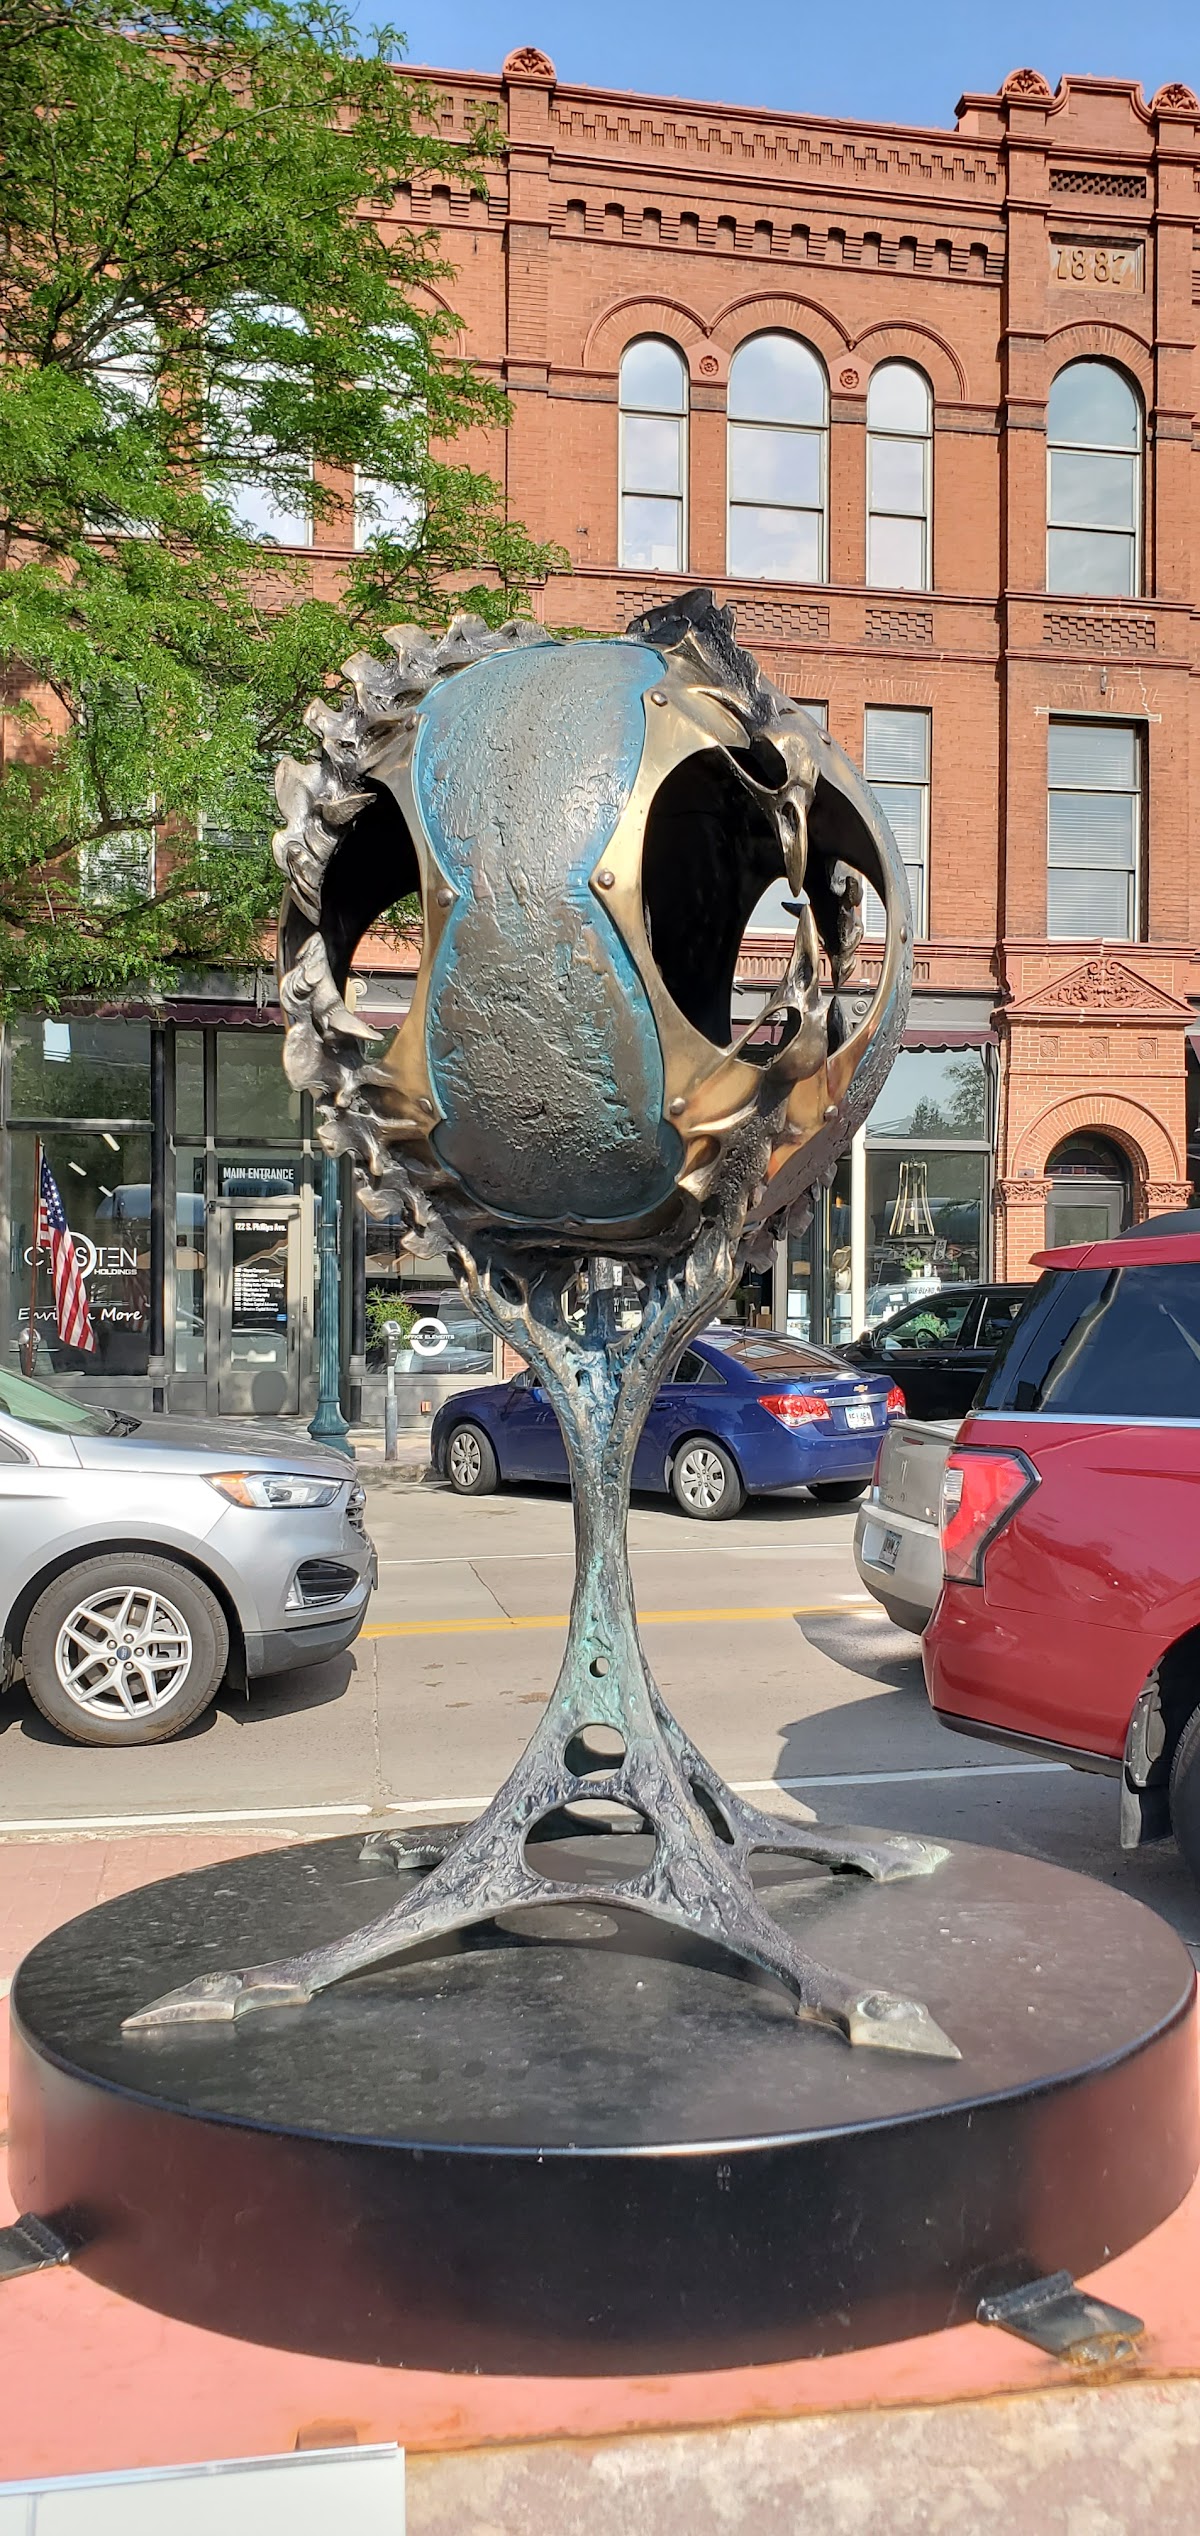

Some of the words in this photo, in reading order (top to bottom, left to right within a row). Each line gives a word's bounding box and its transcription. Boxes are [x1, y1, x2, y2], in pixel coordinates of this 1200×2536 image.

[1056, 248, 1126, 285] 1887
[223, 1167, 246, 1179] MAIN
[248, 1168, 295, 1180] ENTRANCE
[234, 1222, 246, 1231] 122
[101, 1306, 143, 1321] More
